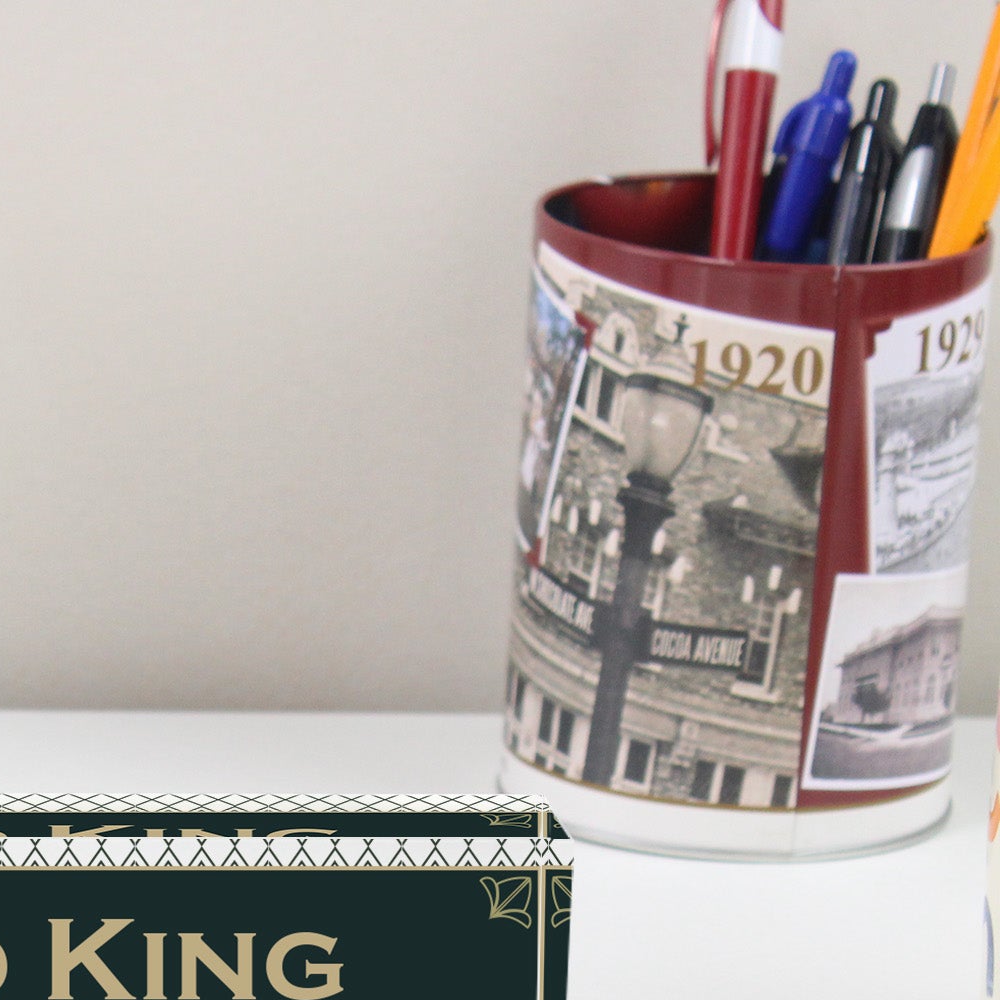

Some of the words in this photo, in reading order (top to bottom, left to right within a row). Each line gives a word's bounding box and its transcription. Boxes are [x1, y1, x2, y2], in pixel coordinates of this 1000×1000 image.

[689, 339, 824, 396] 1920
[916, 309, 985, 374] 1929
[650, 629, 692, 661] COCOA
[693, 635, 746, 667] AVENUE
[48, 919, 345, 1000] KING
